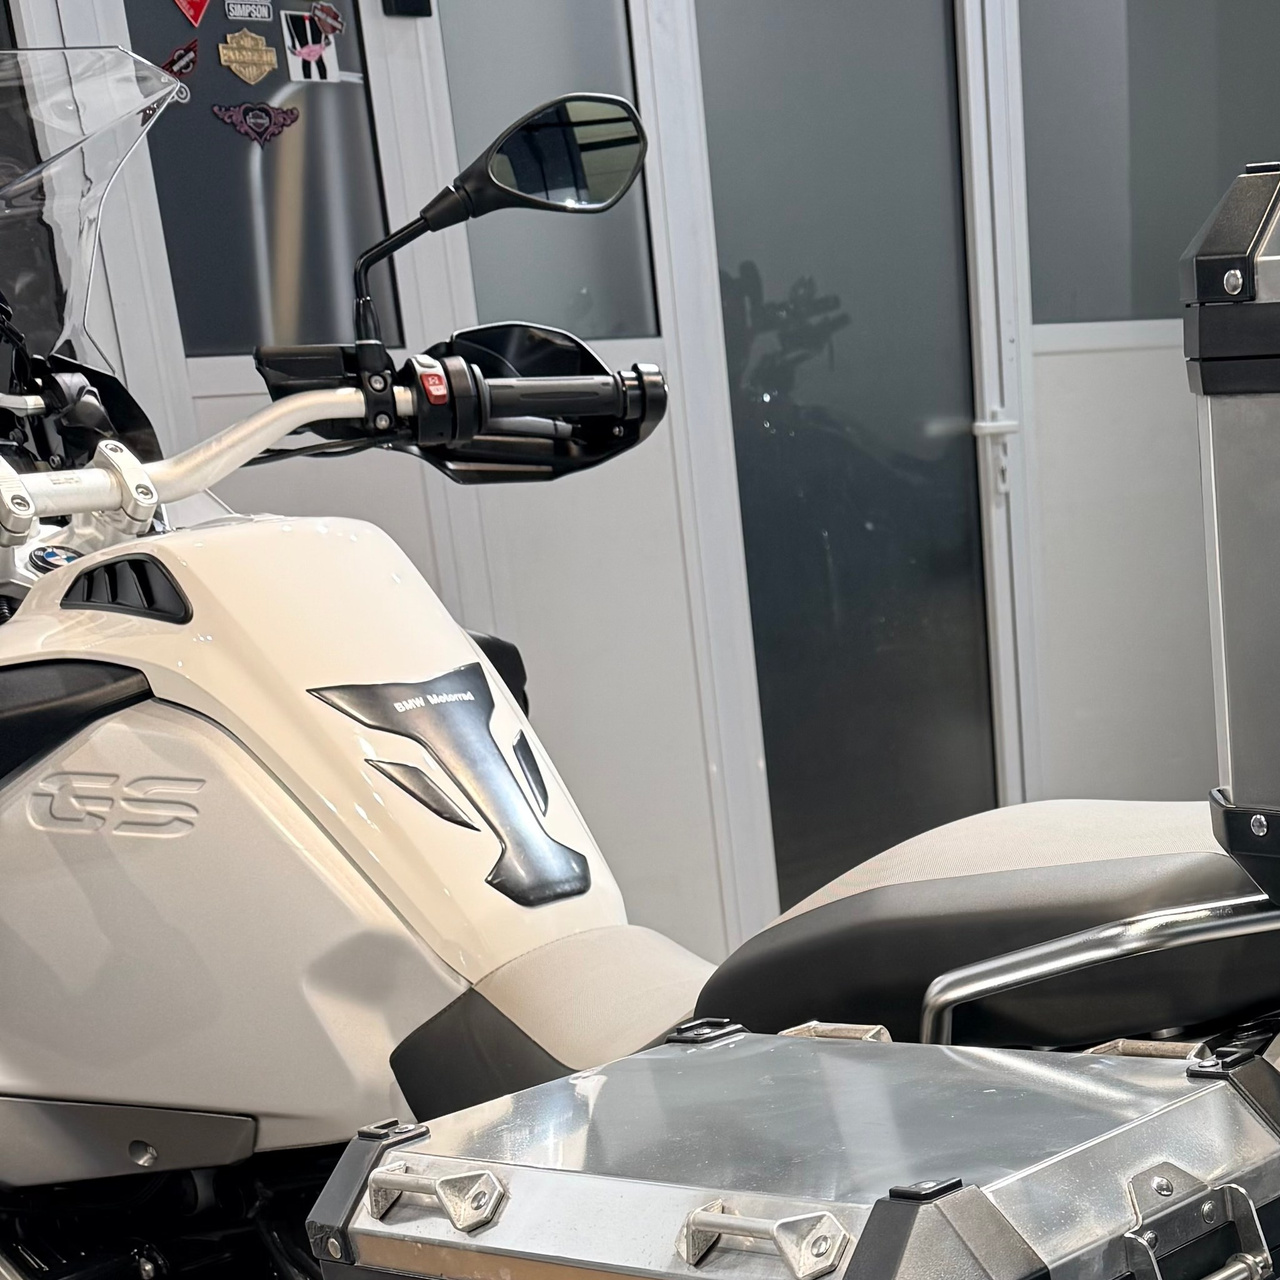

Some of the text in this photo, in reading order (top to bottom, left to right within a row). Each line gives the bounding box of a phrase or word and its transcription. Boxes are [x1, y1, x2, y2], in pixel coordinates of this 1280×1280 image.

[229, 3, 269, 18] SIMPSON
[393, 690, 475, 713] BMW Motorrad
[26, 771, 206, 838] GS
